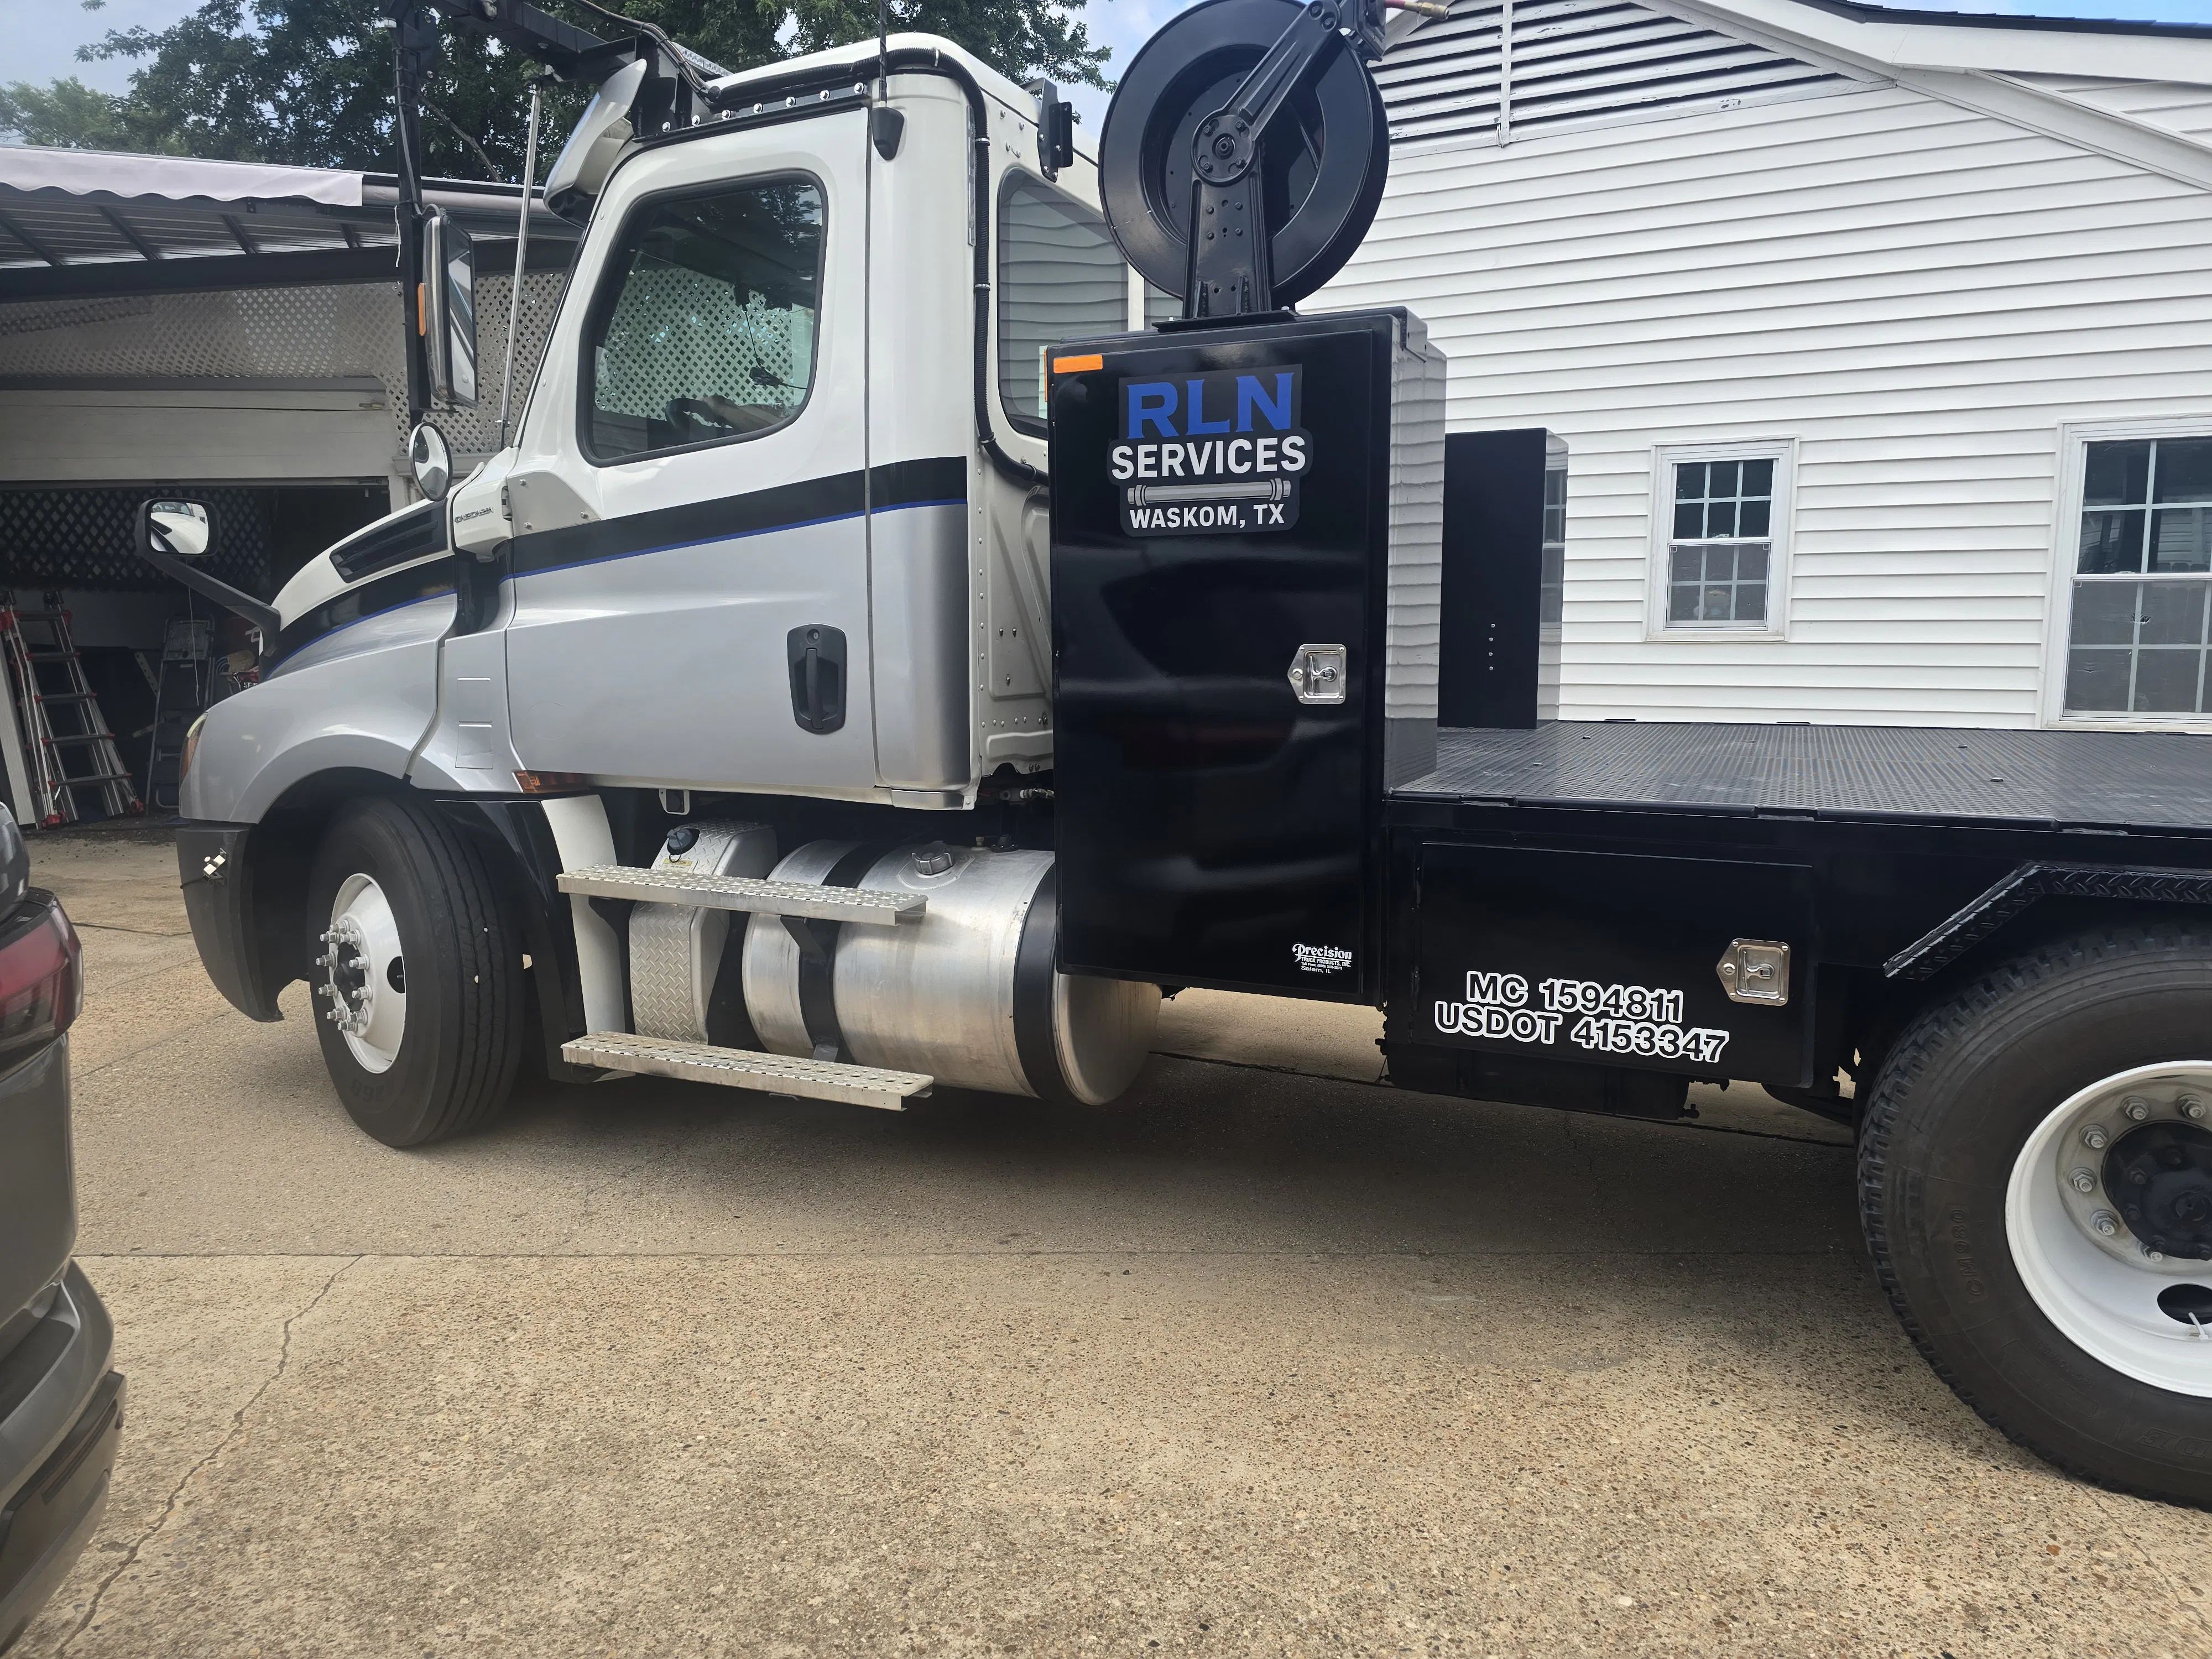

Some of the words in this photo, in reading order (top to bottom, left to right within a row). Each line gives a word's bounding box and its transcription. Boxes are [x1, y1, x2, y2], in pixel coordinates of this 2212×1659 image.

[1126, 372, 1295, 439] RLN
[1112, 435, 1306, 479] SERVICES
[1129, 504, 1245, 529] WASKOM,
[1253, 503, 1285, 524] TX
[1292, 943, 1352, 962] Precision
[1466, 971, 1528, 1006] MC
[1539, 978, 1683, 1023] 1594811
[1434, 1000, 1563, 1045] USDOT
[1571, 1015, 1730, 1063] 4153347
